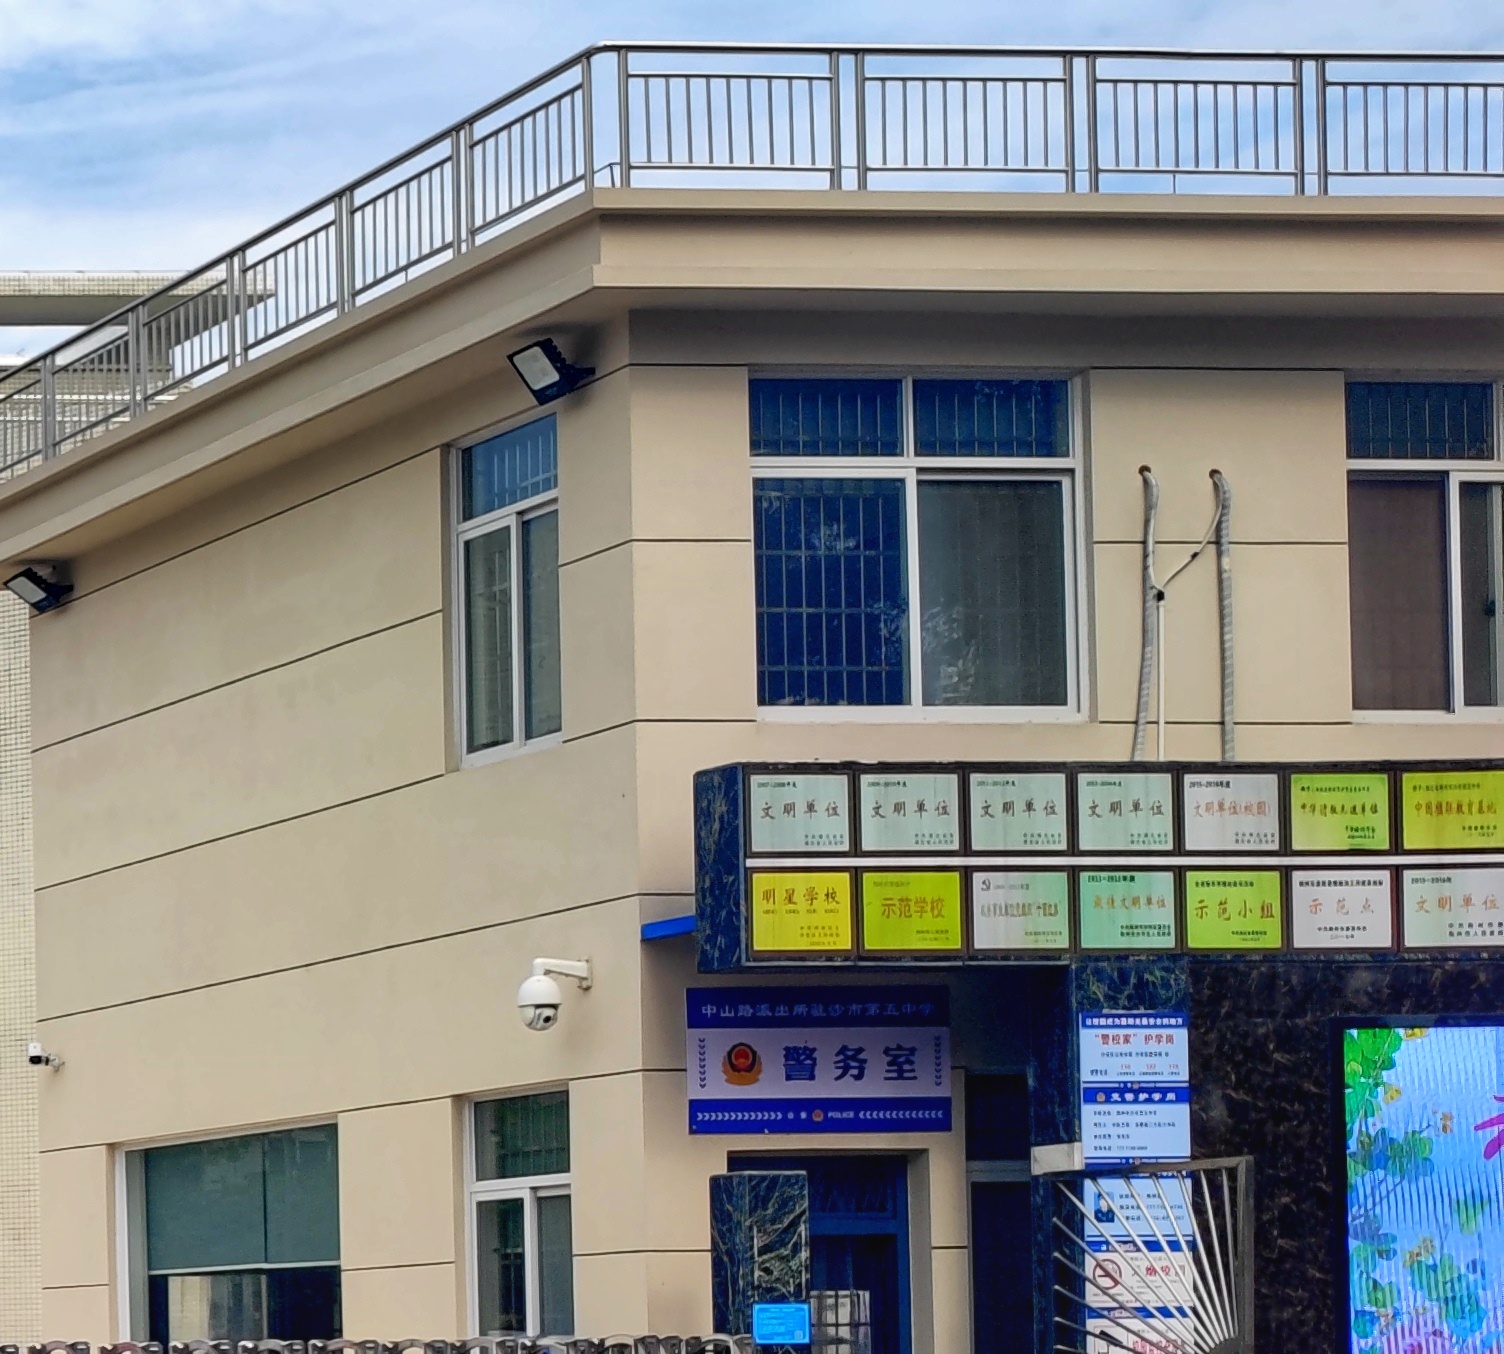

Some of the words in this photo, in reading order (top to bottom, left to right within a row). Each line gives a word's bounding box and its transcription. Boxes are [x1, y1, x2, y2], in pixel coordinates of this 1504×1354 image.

[760, 799, 841, 820] 文明单位
[870, 799, 951, 819] 文明单位
[980, 798, 1058, 819] 文明单位
[1088, 798, 1165, 819] 文明单位
[762, 886, 841, 906] 明星学校
[1308, 896, 1375, 915] 示范点
[1415, 893, 1499, 913] 文明单位
[880, 896, 945, 919] 示范学校
[1195, 898, 1275, 921] 示范小组
[702, 1004, 935, 1018] 中山路派出所驻沙市第五中学
[783, 1044, 918, 1081] 警务室
